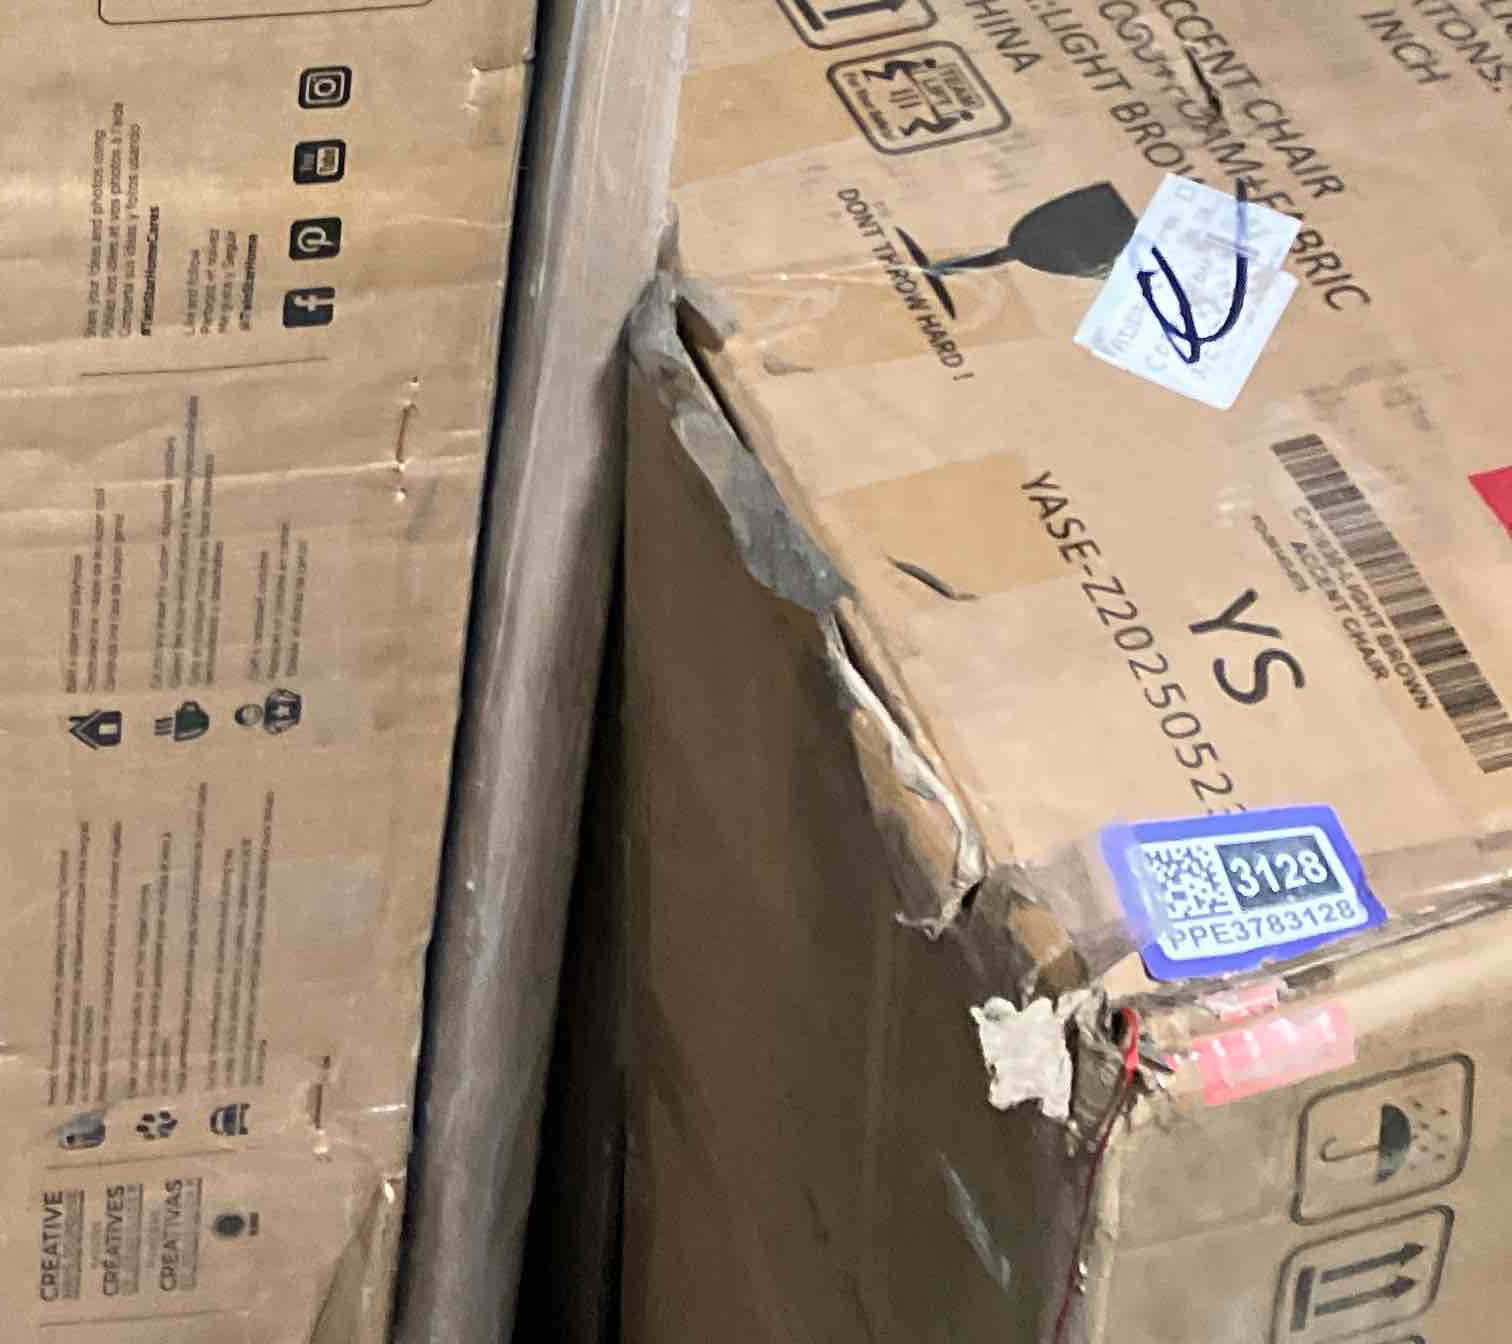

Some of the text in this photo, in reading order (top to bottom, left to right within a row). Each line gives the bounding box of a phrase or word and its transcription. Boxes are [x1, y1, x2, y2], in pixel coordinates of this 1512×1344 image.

[1360, 7, 1453, 87] INCH
[92, 167, 105, 216] photos
[1242, 97, 1347, 200] CHAIR
[915, 311, 964, 370] HARD
[1020, 470, 1248, 816] YASE-Z2025052
[1187, 588, 1307, 705] YS
[1341, 616, 1390, 681] CHAIR
[1228, 849, 1329, 898] 3128
[1167, 899, 1357, 952] PPE3783128
[39, 1190, 65, 1302] CREATIVE
[102, 1184, 126, 1297] CREATIVES
[158, 1177, 184, 1292] CREATIVAS
